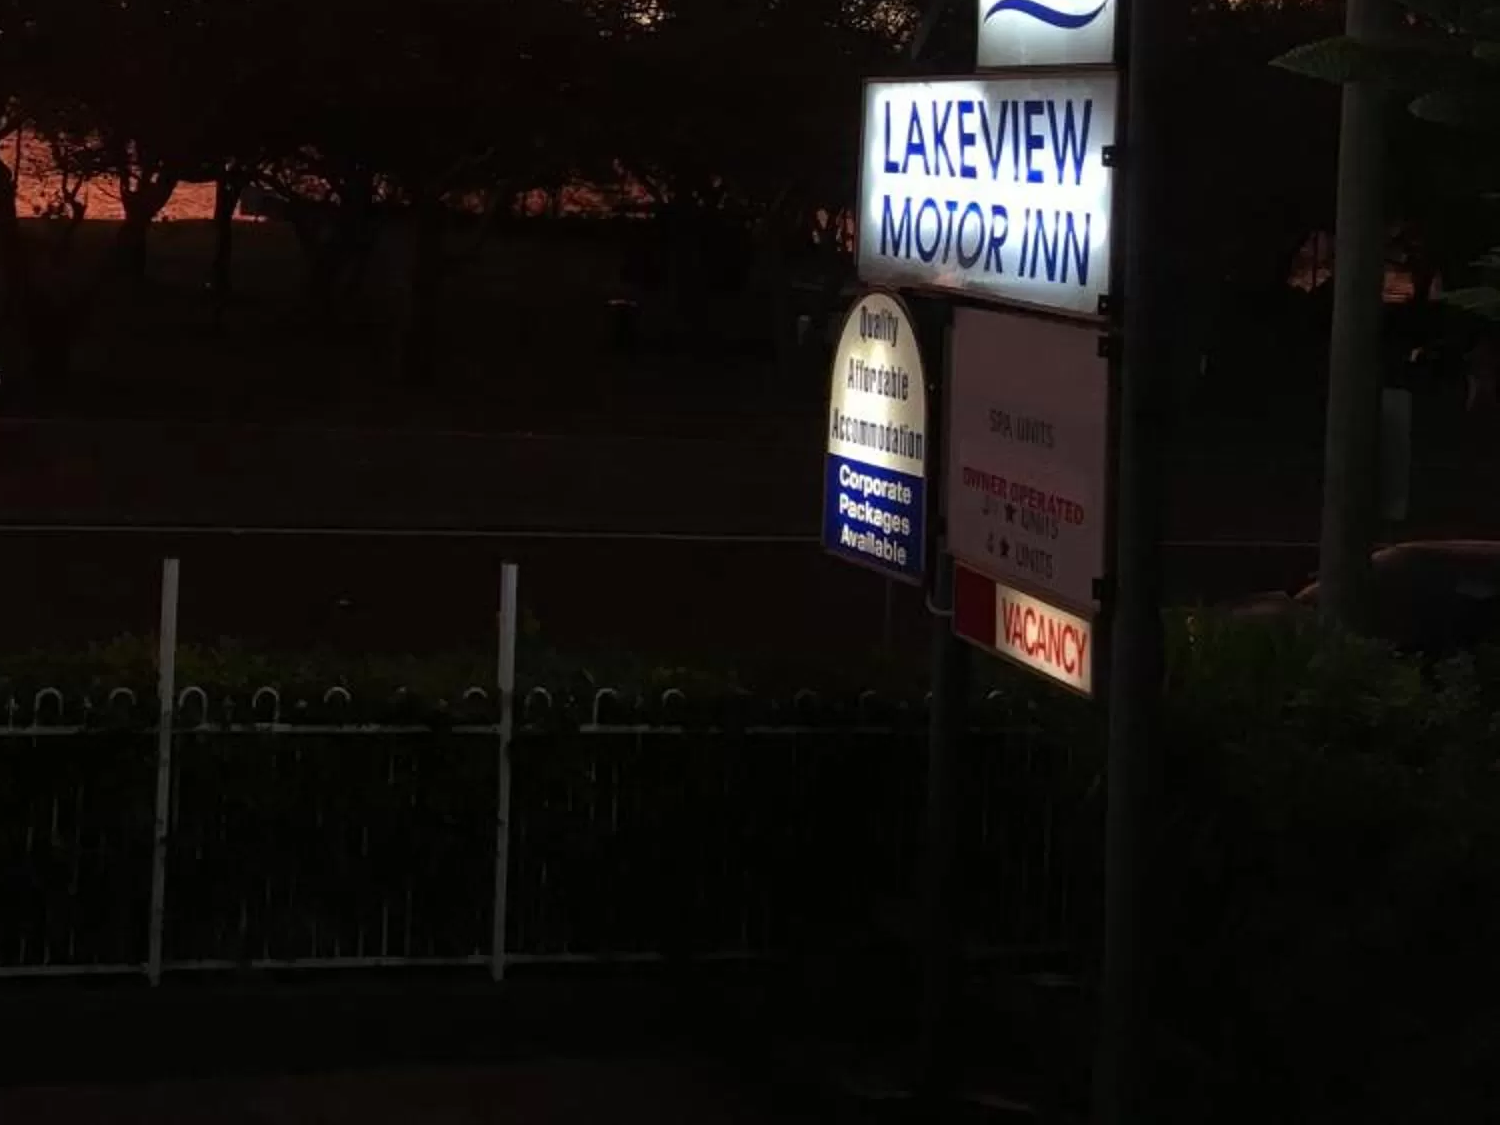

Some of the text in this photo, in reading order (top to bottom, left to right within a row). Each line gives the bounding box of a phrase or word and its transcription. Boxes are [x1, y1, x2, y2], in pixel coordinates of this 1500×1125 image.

[884, 99, 1092, 185] LAKEVIEW
[881, 195, 1090, 286] MOTOR INN
[860, 305, 899, 347] Quality
[847, 359, 908, 401] Affordable
[831, 408, 923, 461] Accommodation
[839, 464, 912, 505] Corporate
[963, 466, 1007, 499] OWNER
[1010, 482, 1085, 526] OPERATED
[839, 493, 911, 536] Packages
[840, 523, 908, 566] Available
[1001, 597, 1088, 679] VACANCY
